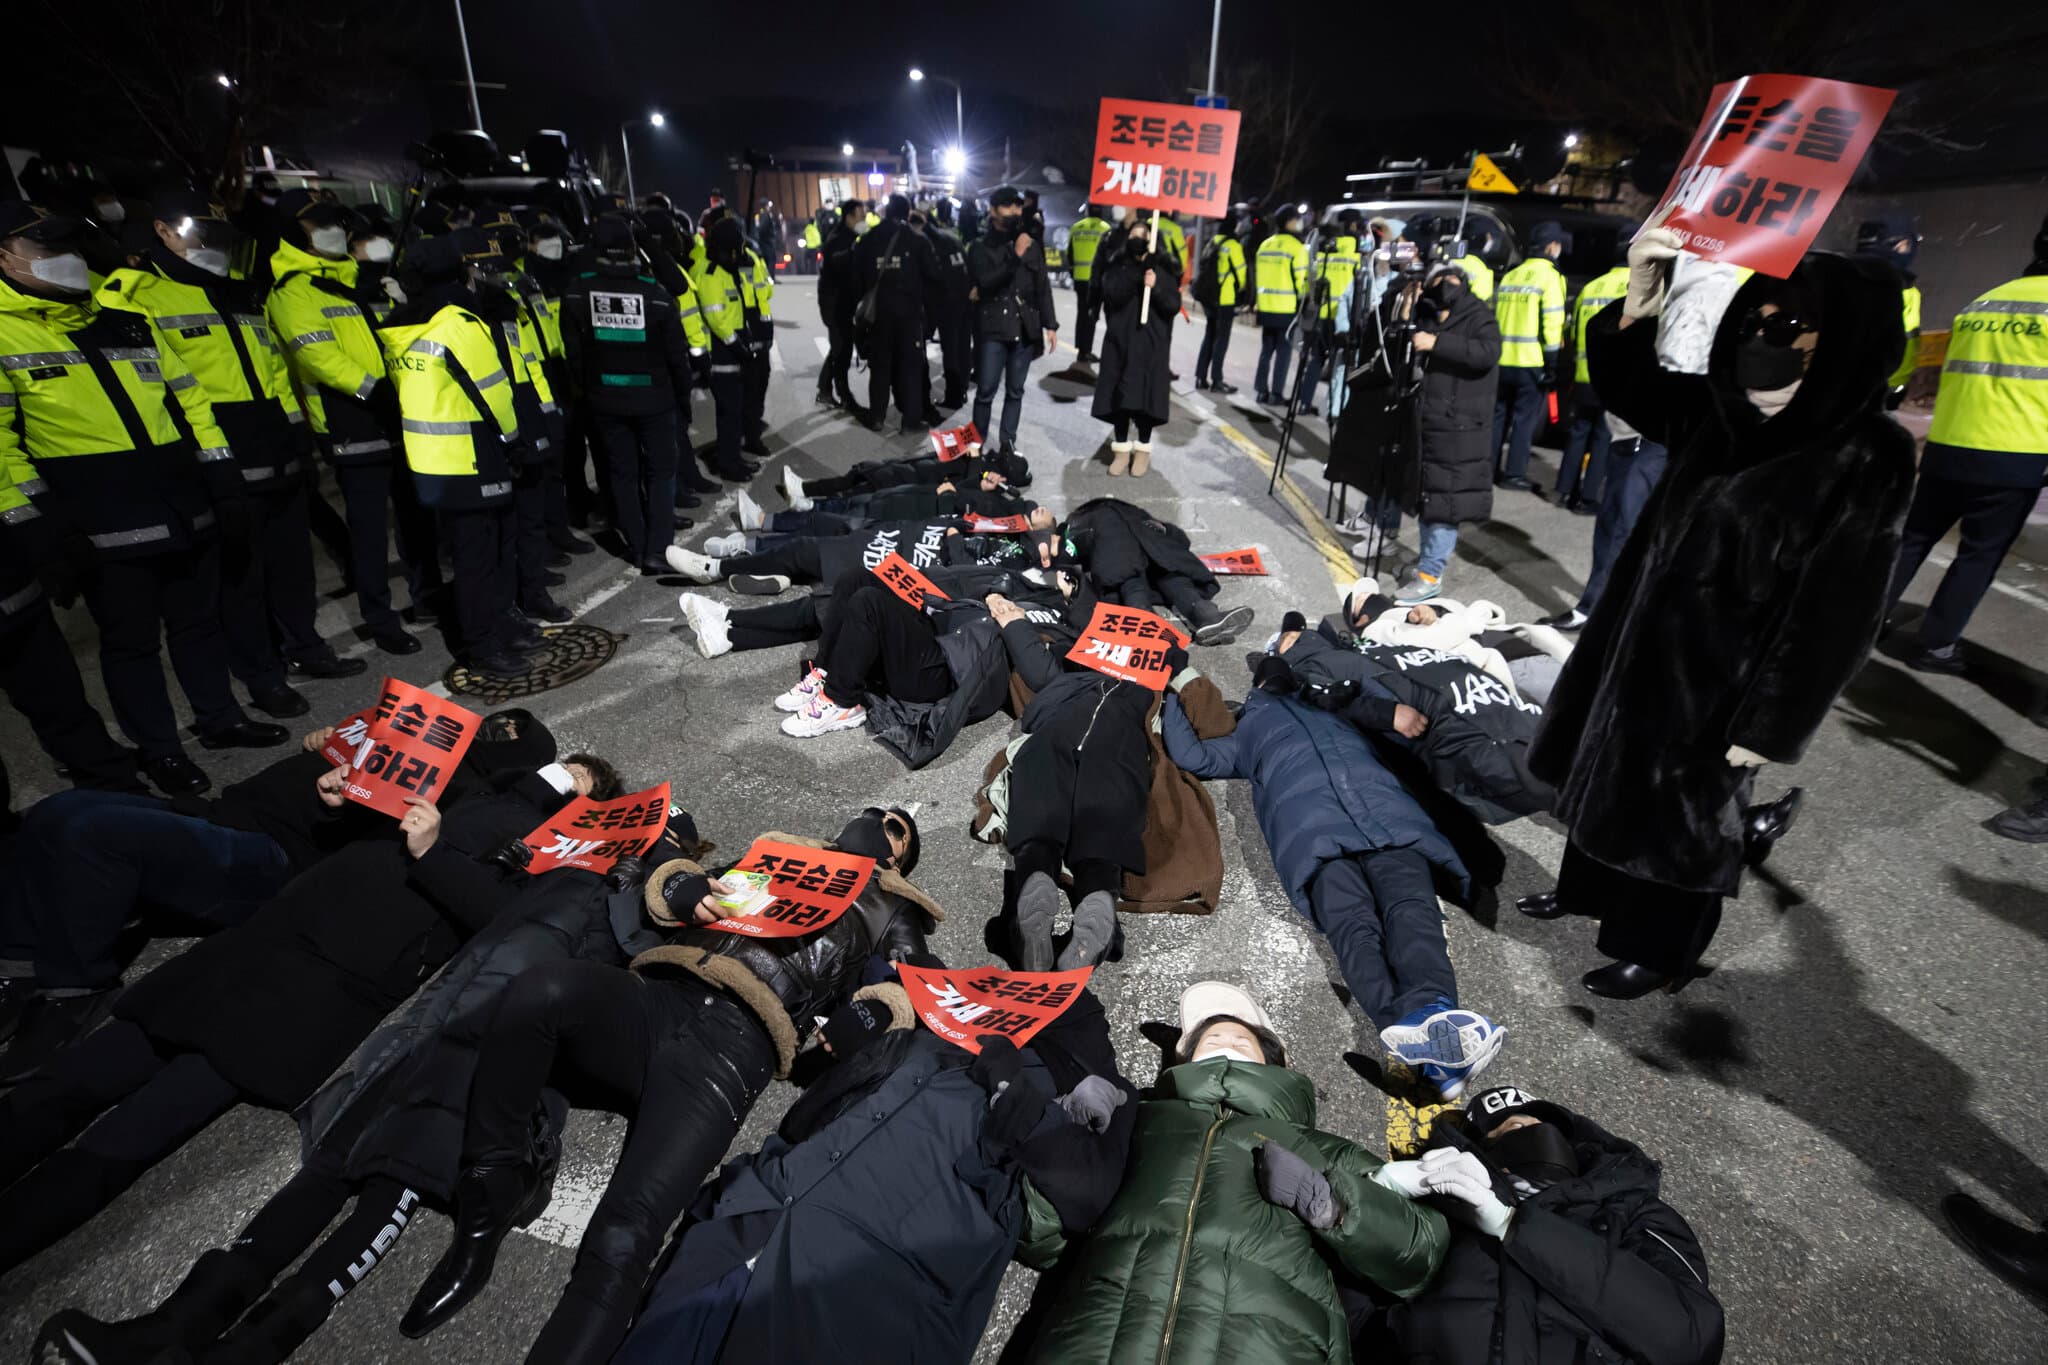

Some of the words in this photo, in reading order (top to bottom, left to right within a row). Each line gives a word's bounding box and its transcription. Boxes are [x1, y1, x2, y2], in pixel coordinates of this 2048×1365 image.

[1110, 113, 1224, 155] 조두순을
[1704, 96, 1862, 163] 두순을
[1102, 158, 1218, 202] 거세하라
[597, 314, 639, 325] POLICE
[1959, 319, 2041, 337] POLICE
[911, 525, 947, 572] NEVE
[882, 562, 928, 604] 조두순
[375, 692, 465, 753] 두순을
[571, 797, 665, 831] 조두순을
[924, 982, 1042, 1036] 거세하라
[967, 975, 1079, 1009] 조두순을
